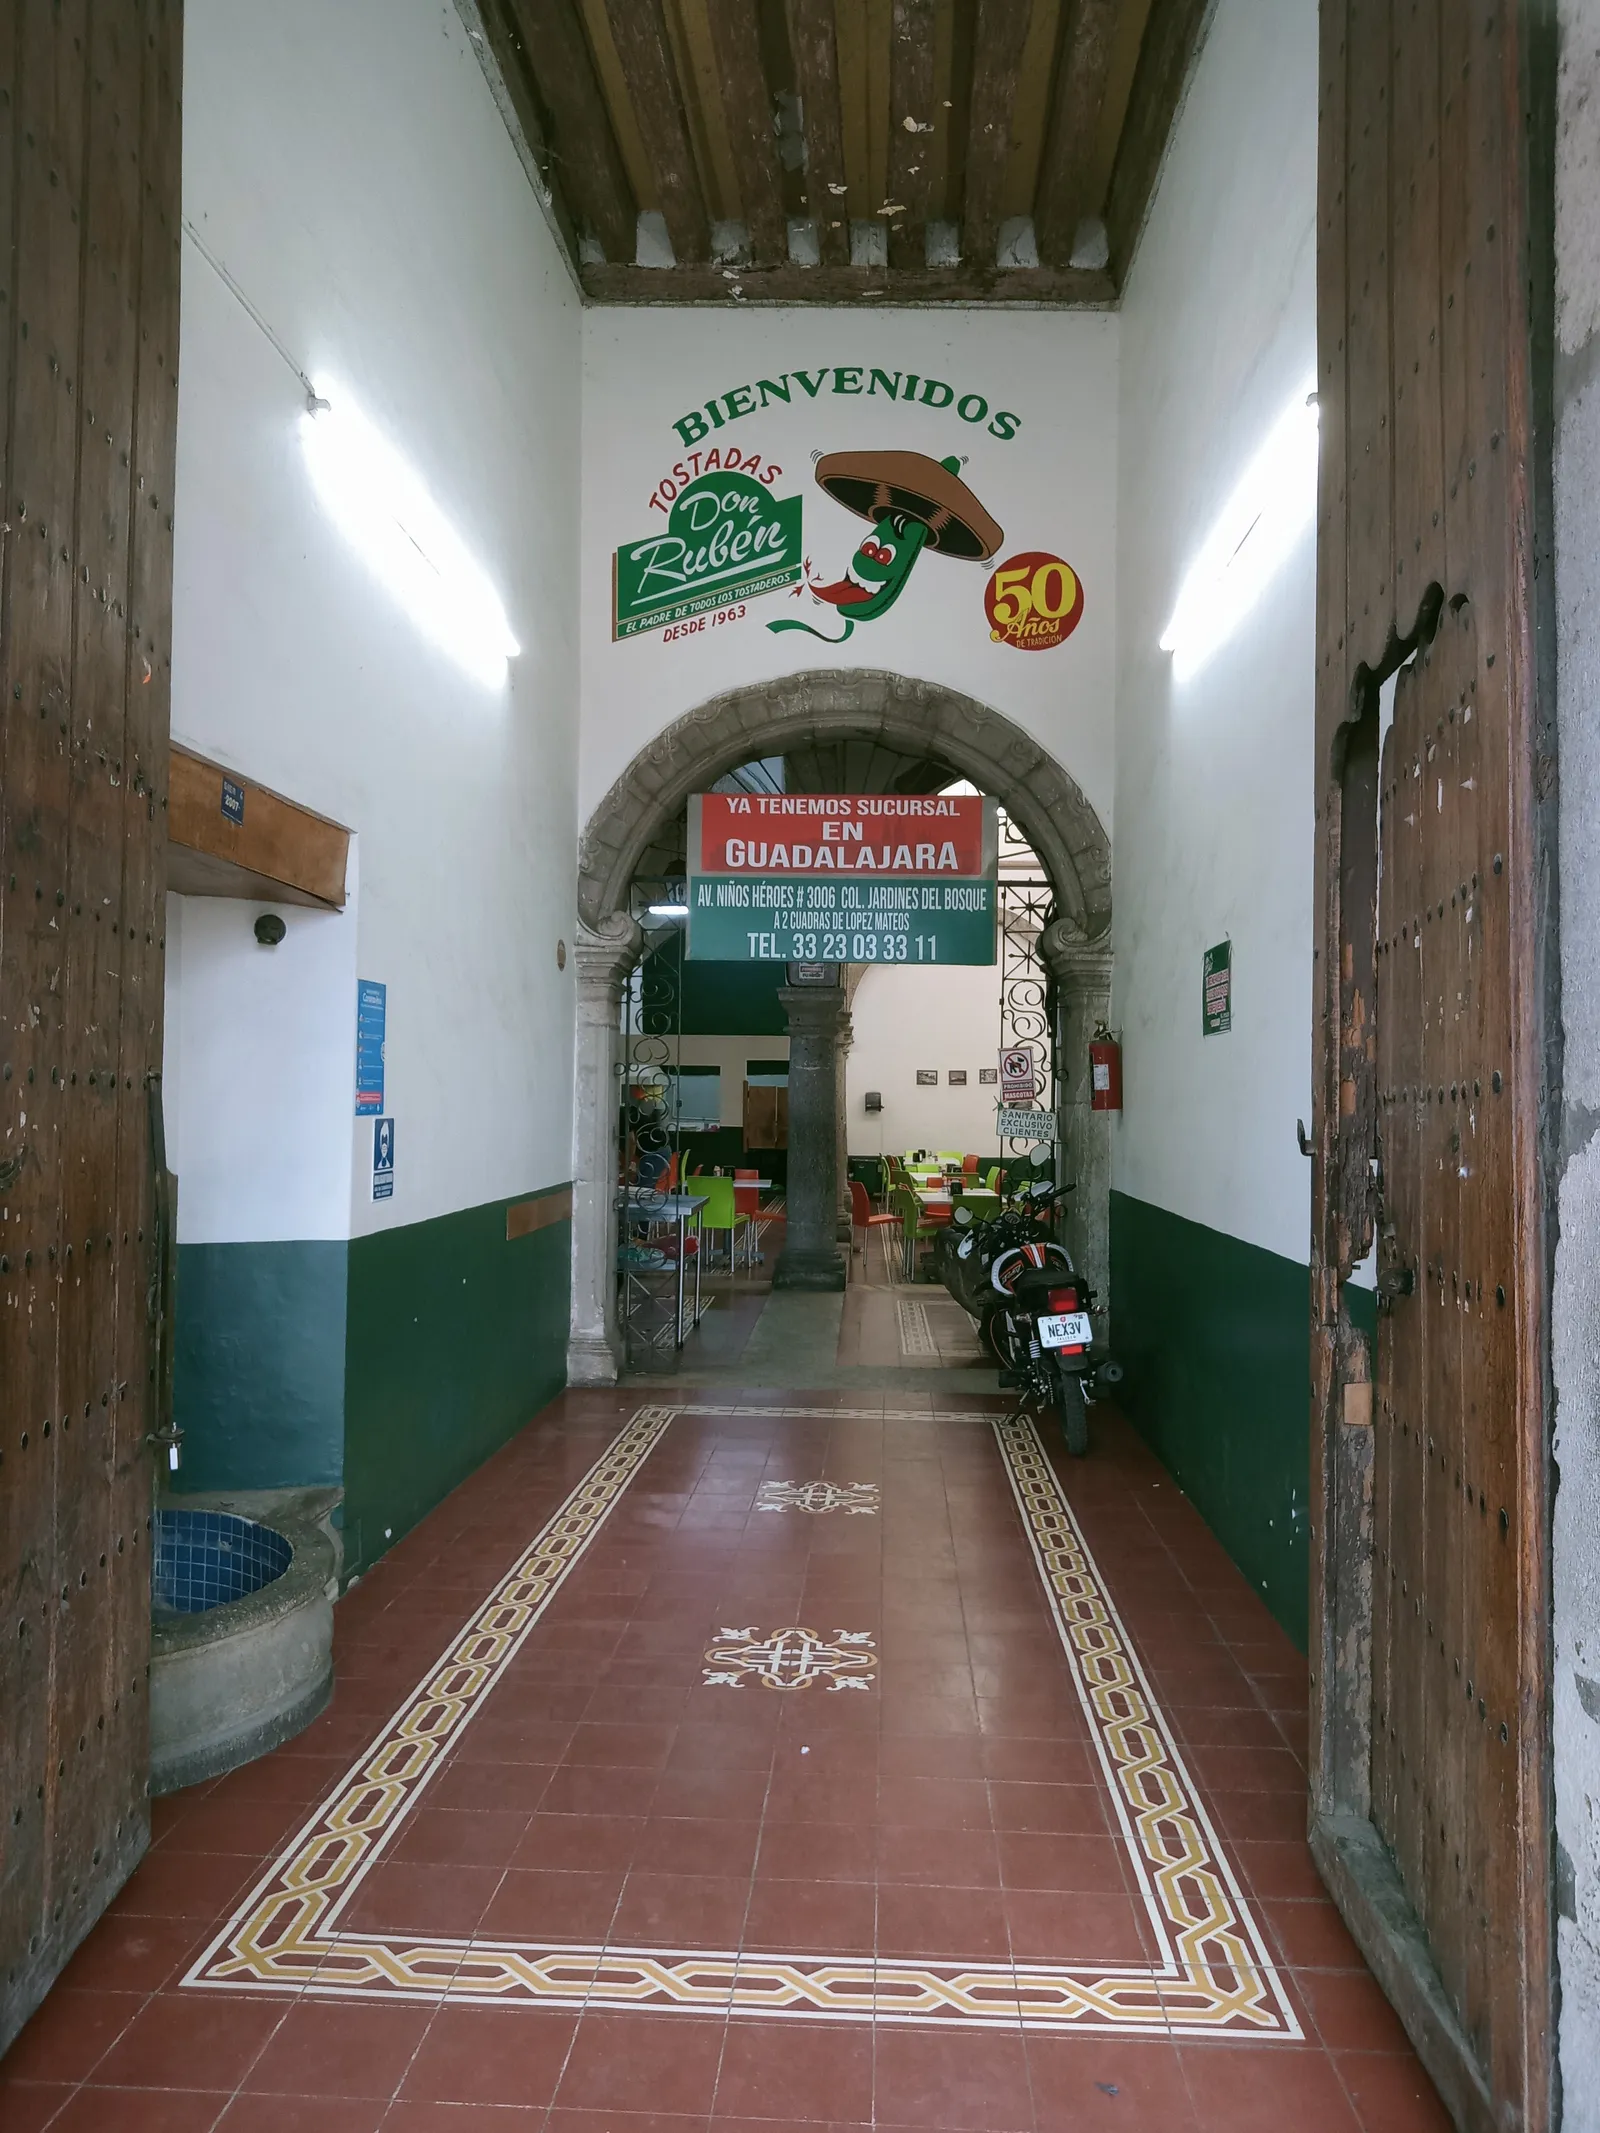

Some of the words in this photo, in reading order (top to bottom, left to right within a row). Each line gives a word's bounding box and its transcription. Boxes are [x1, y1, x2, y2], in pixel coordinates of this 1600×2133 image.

[672, 367, 1022, 448] BIENVENIDOS
[649, 447, 782, 514] TOSTADAS
[680, 490, 759, 531] Don
[631, 515, 787, 593] Rubén
[626, 623, 637, 632] EL
[640, 611, 671, 628] PADRE
[675, 607, 687, 617] DE
[690, 598, 716, 612] TODOS
[717, 591, 733, 604] LOS
[735, 573, 790, 598] TOSTADEROS
[994, 563, 1076, 624] 50
[663, 617, 705, 642] DESDE
[712, 605, 746, 627] 1963
[990, 608, 1060, 643] Años
[1016, 639, 1025, 647] DE
[726, 798, 751, 813] YA
[757, 798, 851, 815] TENEMOS
[857, 800, 960, 816] SUCURSAL
[822, 822, 863, 840] EN
[726, 838, 958, 870] GUADALAJARA
[698, 884, 713, 907] AV.
[717, 881, 749, 907] NIÑOS
[752, 881, 794, 908] HÉROES
[797, 886, 803, 908] #
[807, 886, 835, 908] 3006
[841, 886, 864, 909] COL.
[868, 887, 918, 910] JARDINES
[922, 888, 941, 910] DEL
[945, 888, 986, 912] BOSQUE
[774, 911, 779, 929] A
[782, 911, 787, 929] 2
[791, 912, 830, 930] CUADRAS
[833, 912, 843, 930] DE
[846, 912, 872, 930] LOPEZ
[875, 913, 909, 931] MATEOS
[747, 933, 786, 958] TEL.
[792, 933, 817, 959] 33
[822, 934, 847, 959] 23
[852, 934, 877, 960] 03
[883, 934, 907, 960] 33
[915, 935, 936, 960] 11
[1004, 1091, 1033, 1099] MASCOTAS
[1001, 1119, 1052, 1129] EXCLUSIVO
[1002, 1111, 1052, 1121] SANITARIO
[1003, 1128, 1049, 1137] CLIENTES
[1048, 1321, 1081, 1338] NEX3V
